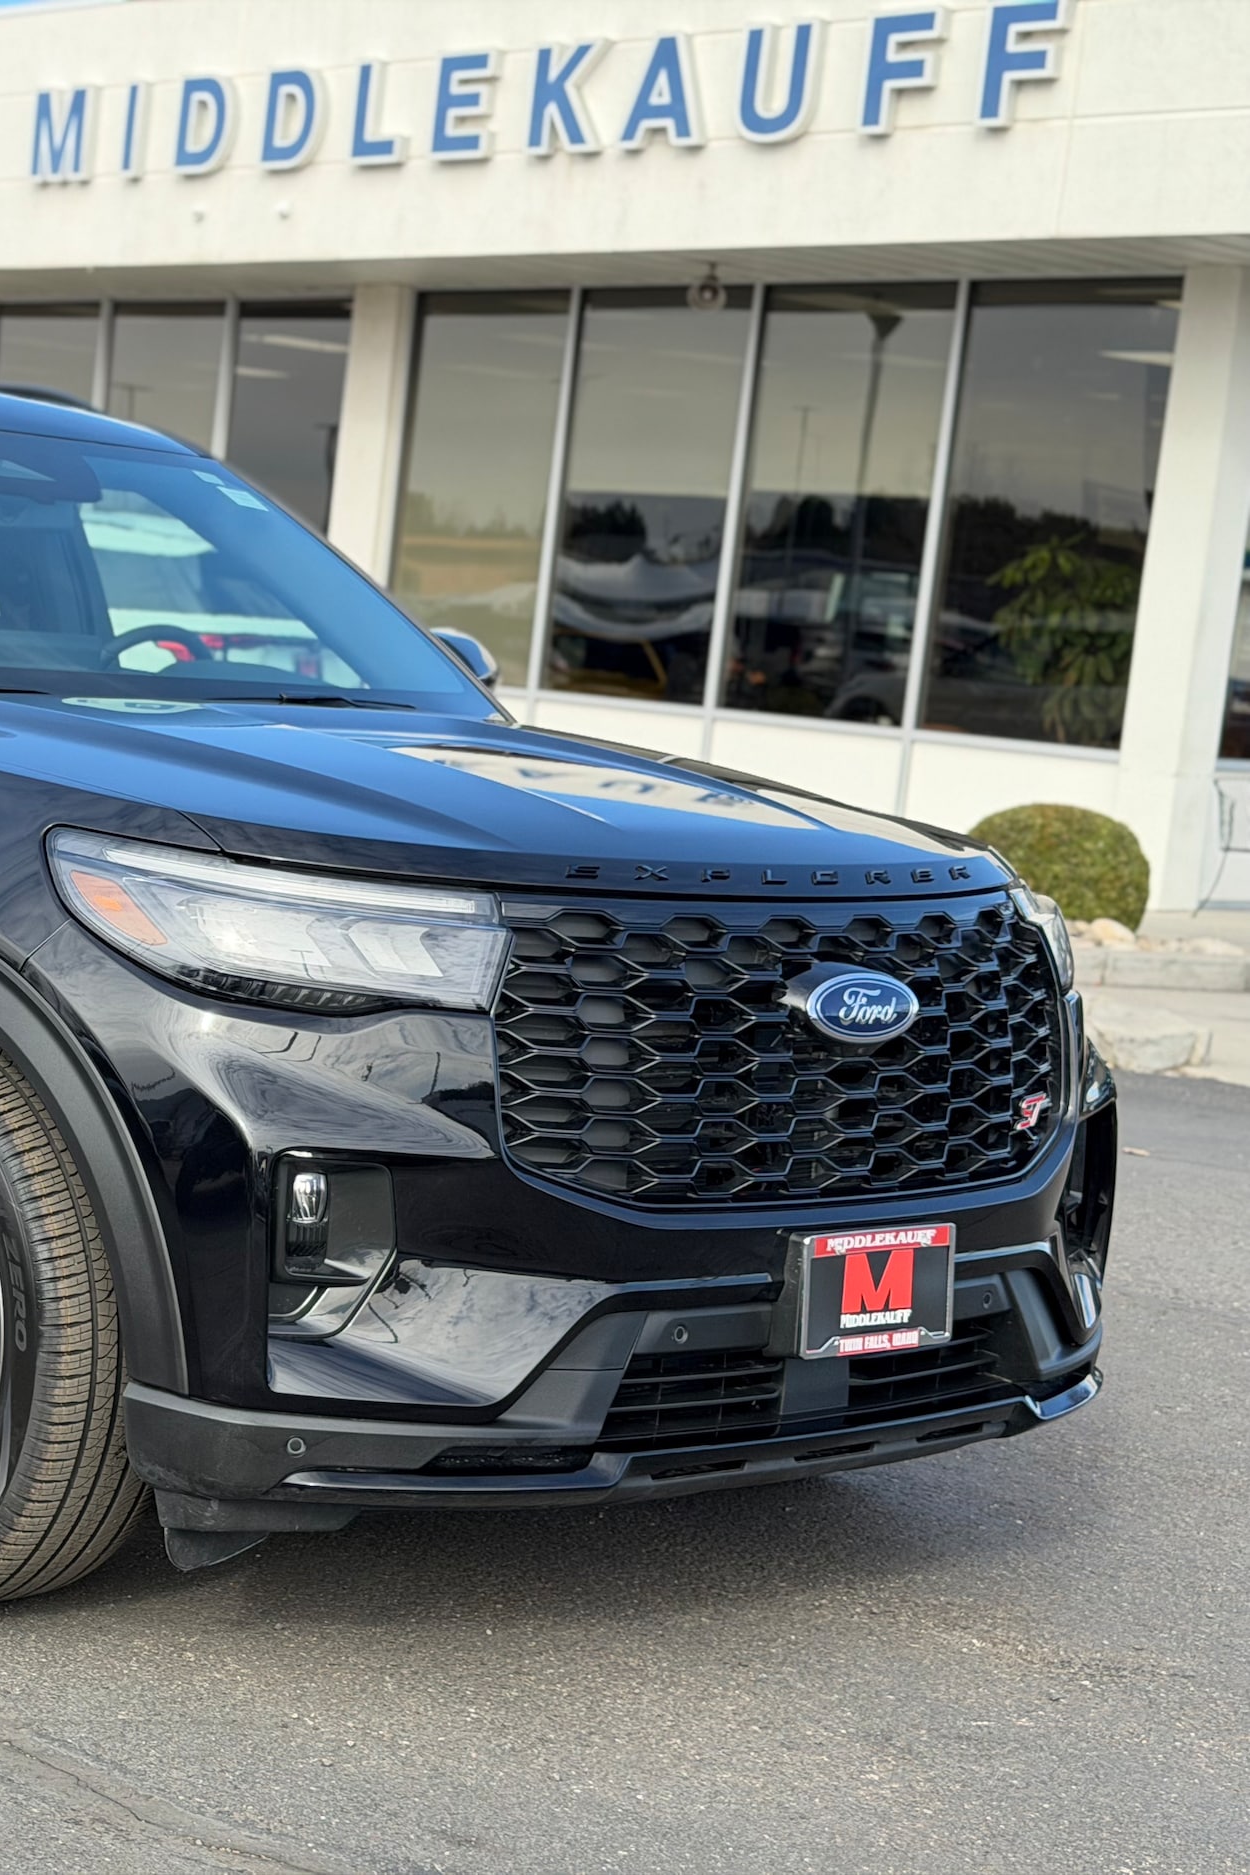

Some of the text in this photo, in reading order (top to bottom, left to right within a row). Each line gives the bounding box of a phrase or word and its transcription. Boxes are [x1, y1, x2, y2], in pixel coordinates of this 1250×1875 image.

[31, 2, 1068, 184] MIDDLEKAUFF
[565, 864, 972, 886] EXPLORER
[838, 987, 898, 1025] Ford
[1, 1233, 27, 1352] ZERO
[841, 1248, 914, 1313] M
